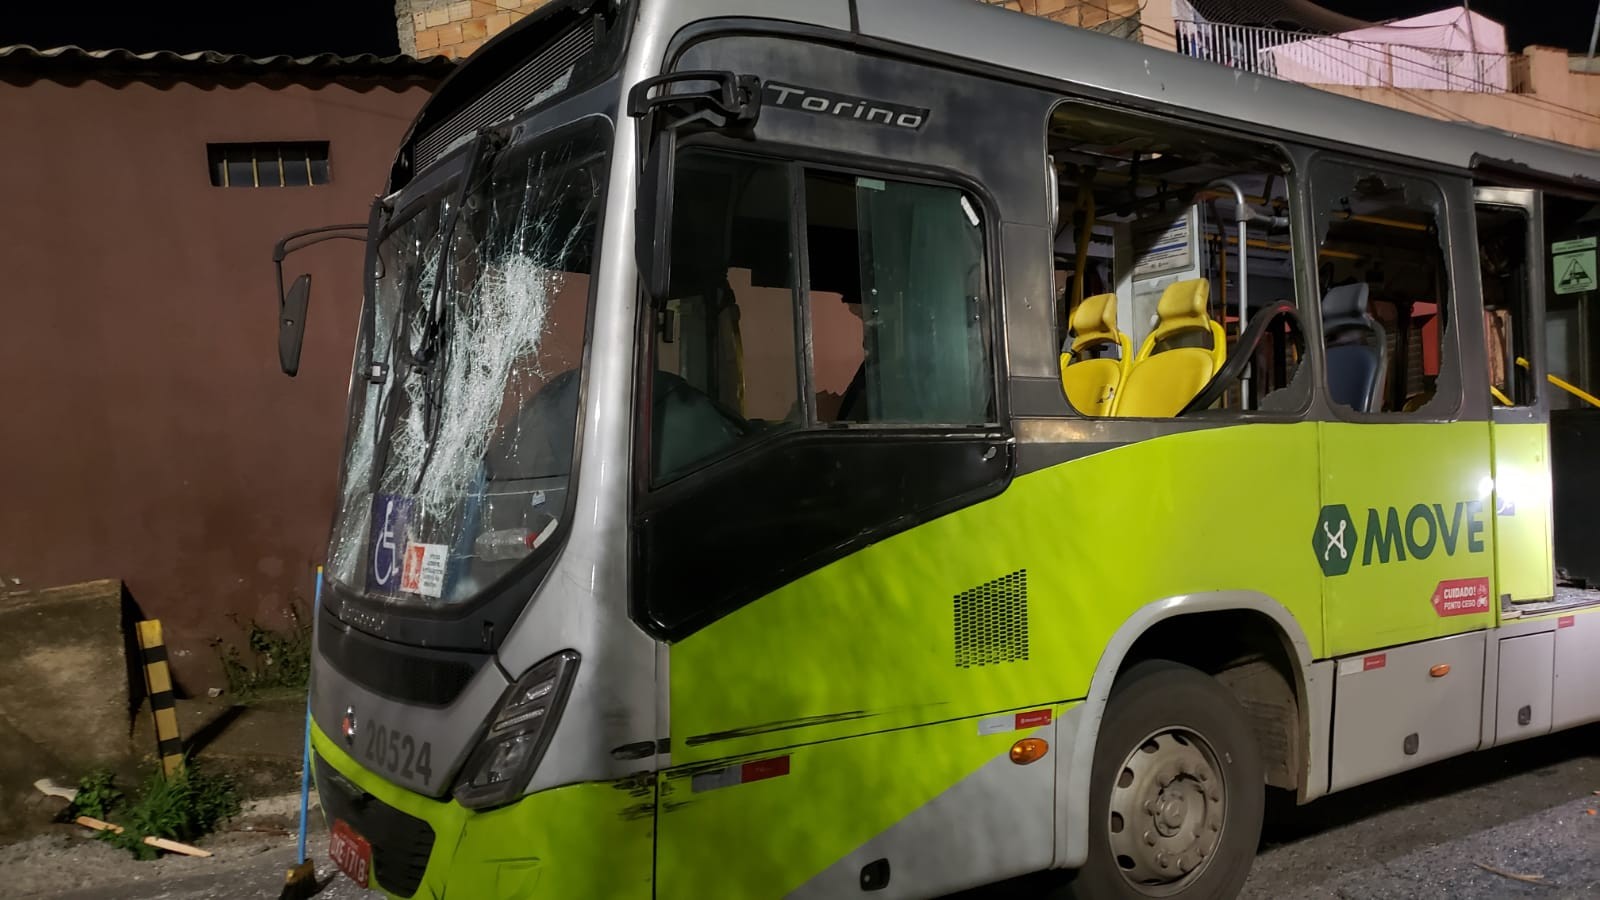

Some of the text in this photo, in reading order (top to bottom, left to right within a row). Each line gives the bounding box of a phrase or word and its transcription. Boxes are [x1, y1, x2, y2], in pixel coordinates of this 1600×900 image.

[768, 85, 922, 128] Torino
[1362, 501, 1484, 566] MOVE
[1444, 585, 1476, 600] CUIDADO!
[365, 719, 432, 786] 20524
